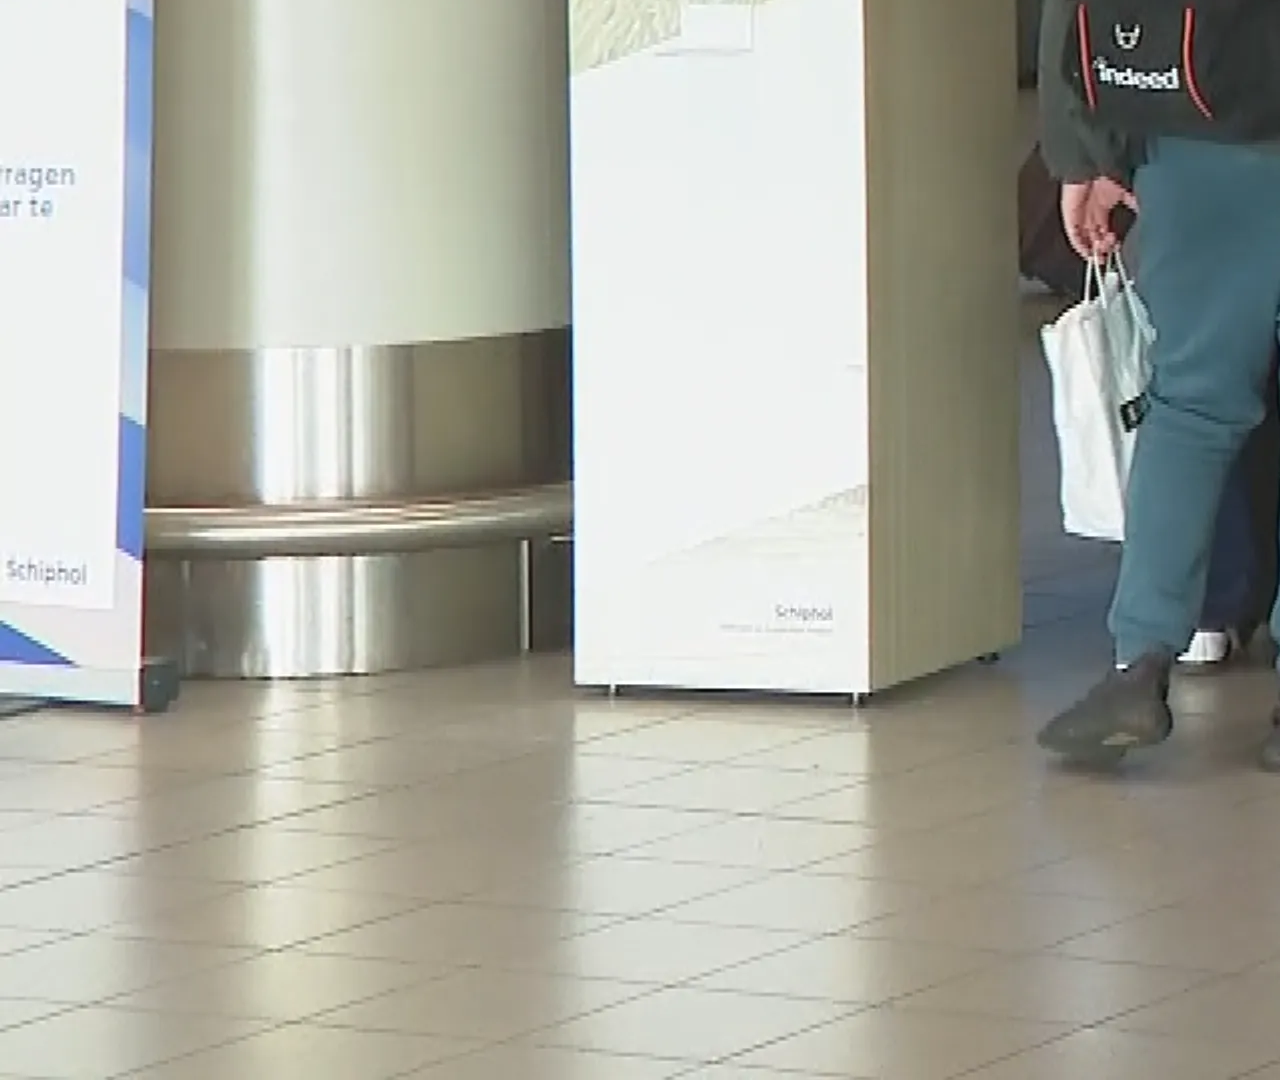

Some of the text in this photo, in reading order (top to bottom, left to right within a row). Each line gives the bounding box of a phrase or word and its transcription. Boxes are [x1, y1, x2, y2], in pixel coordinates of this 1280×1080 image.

[1095, 58, 1180, 89] indeed
[29, 196, 54, 218] te
[6, 557, 87, 587] Schiphol
